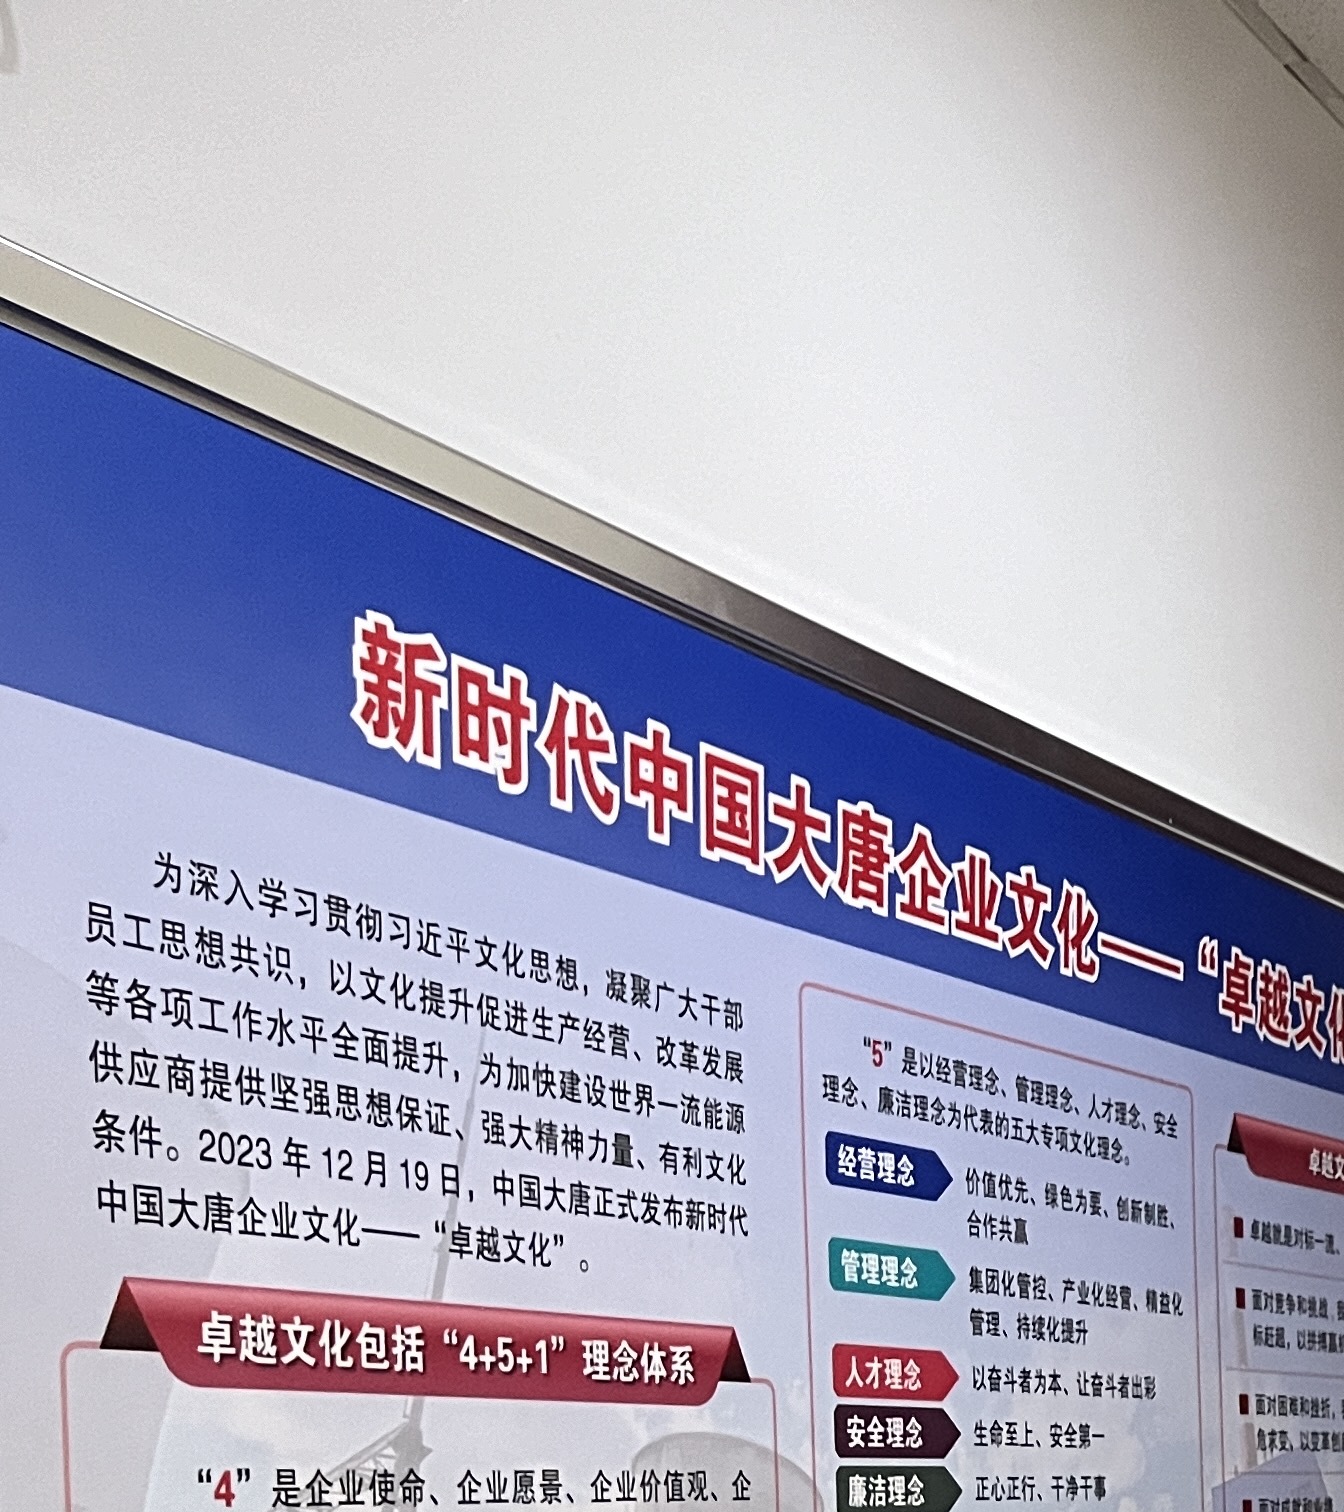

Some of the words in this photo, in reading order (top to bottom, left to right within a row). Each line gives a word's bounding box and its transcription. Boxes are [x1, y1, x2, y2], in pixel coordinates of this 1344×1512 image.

[153, 851, 744, 1031] 为深入学习贯彻习近平文化思想，凝聚广大干部
[85, 901, 744, 1083] 员工思想共识，以文化提升促进生产经营、改革发展
[85, 970, 745, 1135] 等各项工作水平全面提升，为加快建设世界一流能源
[88, 1039, 747, 1186] 供应商提供坚强思想保证、强大精神力量、有利文化
[837, 1144, 915, 1187] 经营理念
[967, 1209, 1029, 1245] 合作共赢
[841, 1249, 918, 1289] 管理理念
[969, 1308, 1088, 1345] 管理、持续化提升
[196, 1310, 695, 1385] 卓越文化包括“4+5+1”理念体系
[845, 1356, 922, 1391] 人才理念
[972, 1365, 1157, 1400] 以奋斗者为本、让奋斗者出彩
[846, 1415, 923, 1449] 安全理念
[973, 1421, 1105, 1449] 生命至上、安全第一
[197, 1467, 752, 1509] “4”是企业使命、企业愿景、企业价值观、企
[848, 1475, 925, 1508] 廉洁理念
[975, 1475, 1107, 1502] 正心正行、干净干事
